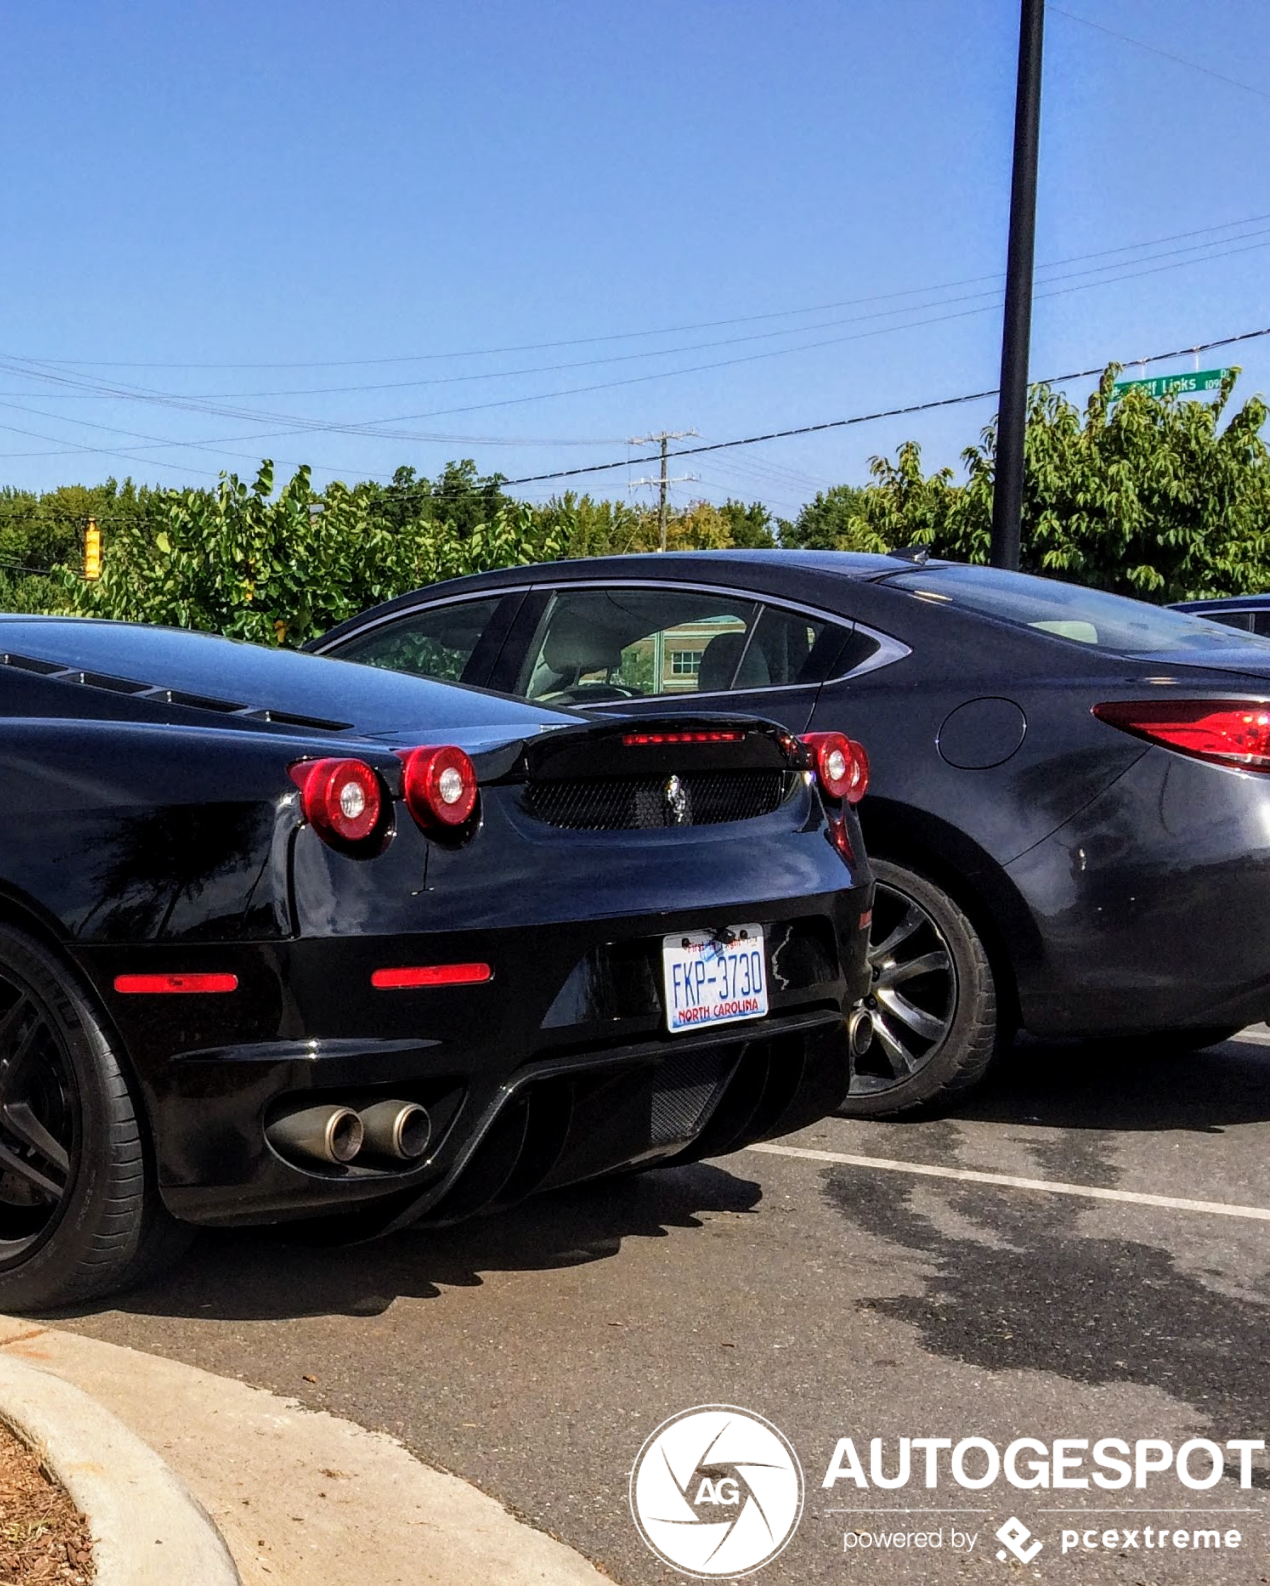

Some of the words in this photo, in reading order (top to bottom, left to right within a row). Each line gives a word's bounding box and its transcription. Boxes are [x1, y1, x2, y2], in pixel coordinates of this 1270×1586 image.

[1162, 377, 1197, 393] Links
[673, 951, 763, 1009] FKP-3730
[678, 1006, 710, 1023] NORTH
[713, 998, 758, 1017] CAROLINA
